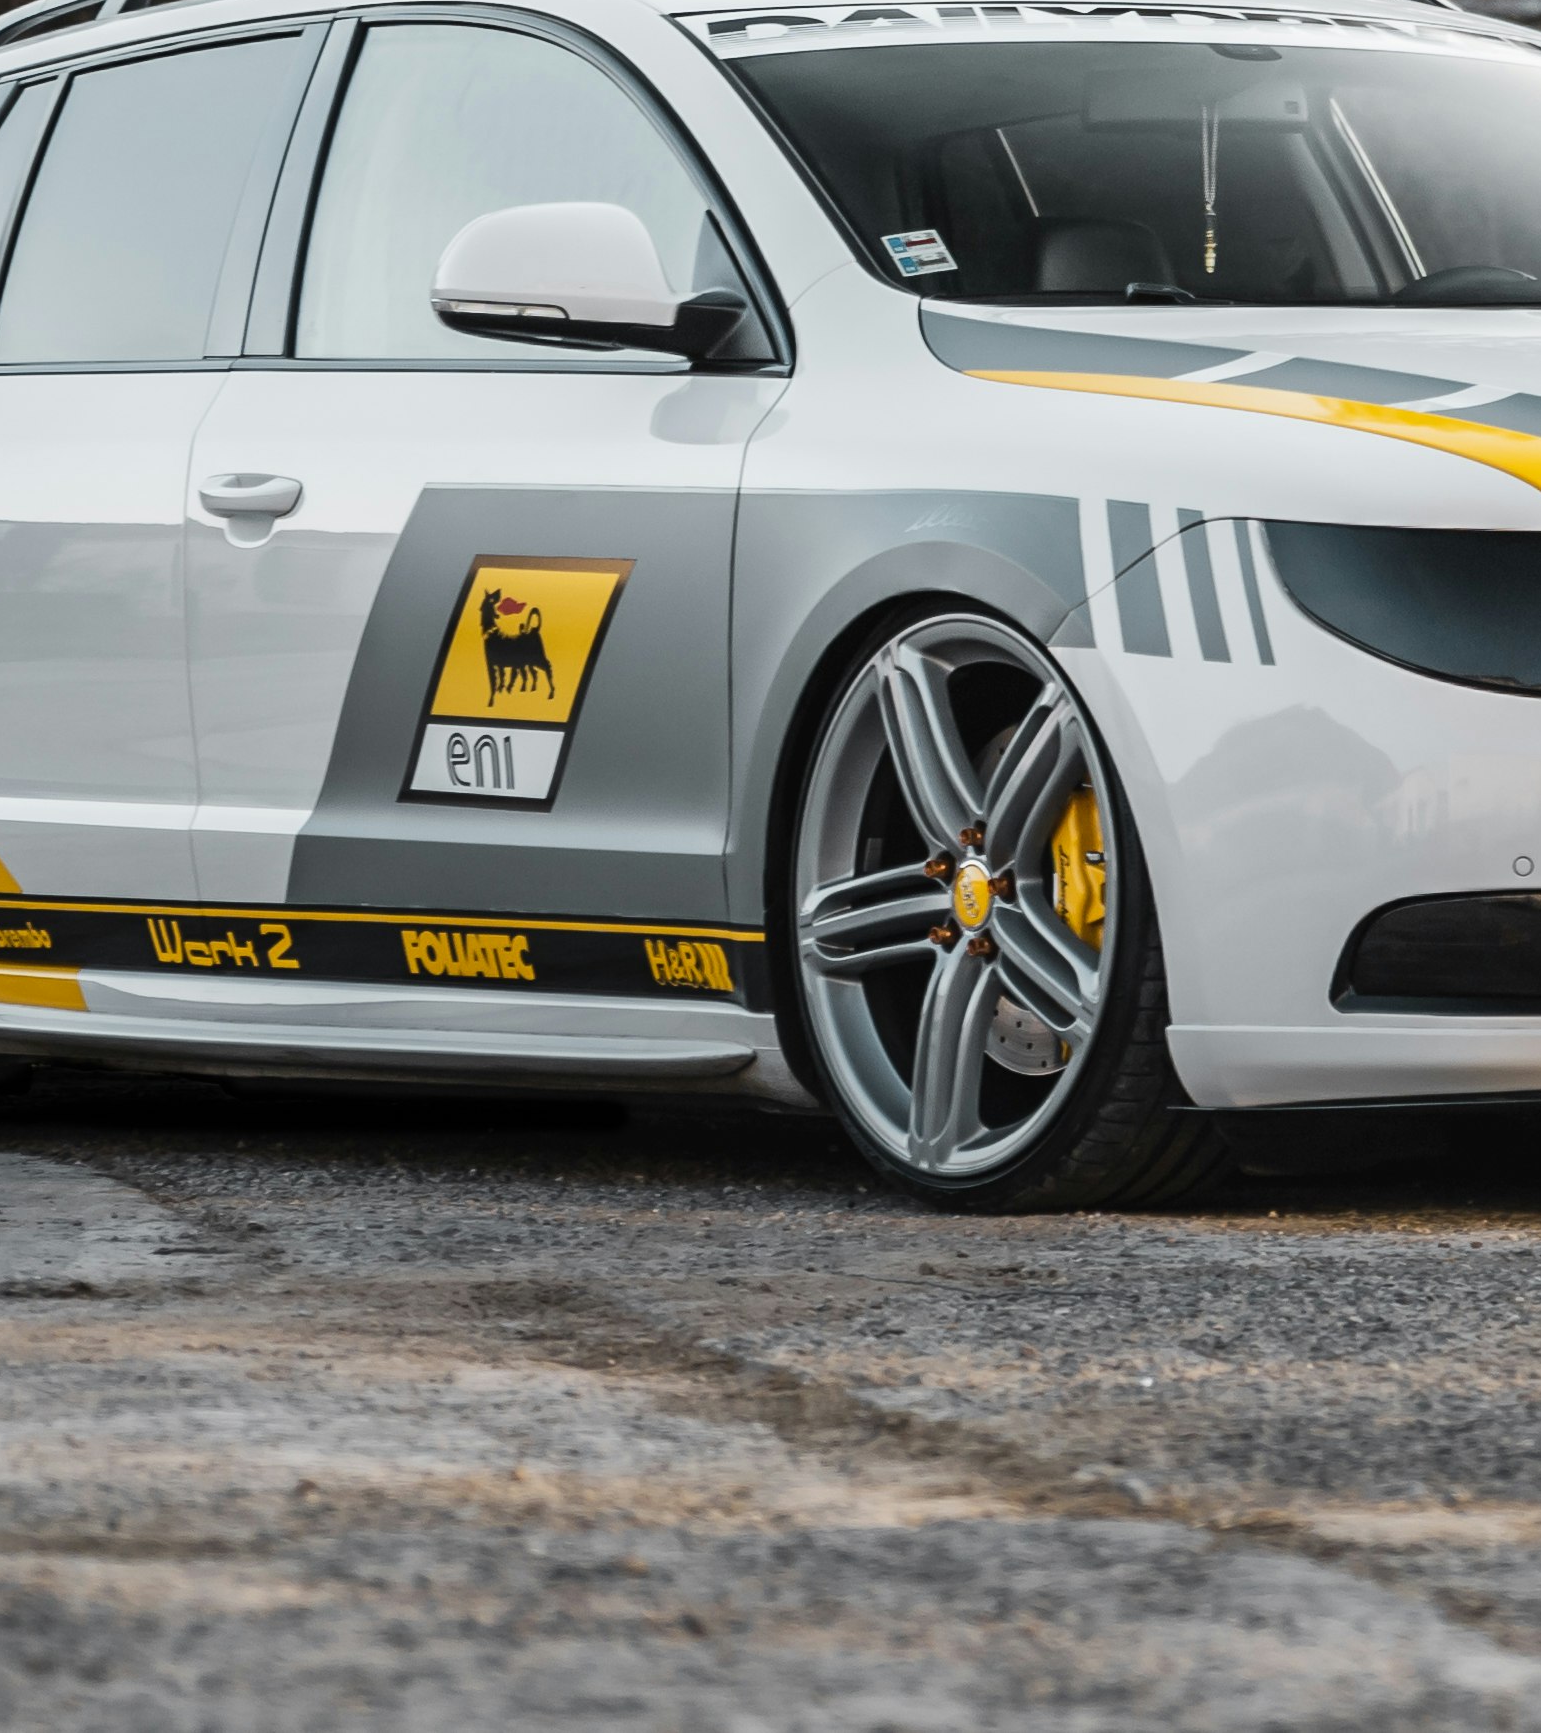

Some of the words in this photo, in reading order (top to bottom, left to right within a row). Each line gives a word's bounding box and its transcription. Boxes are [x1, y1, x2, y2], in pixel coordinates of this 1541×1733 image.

[446, 732, 515, 790] eni
[260, 923, 300, 969] 2
[401, 930, 536, 980] FOLIATEC
[644, 939, 705, 988] H&R
